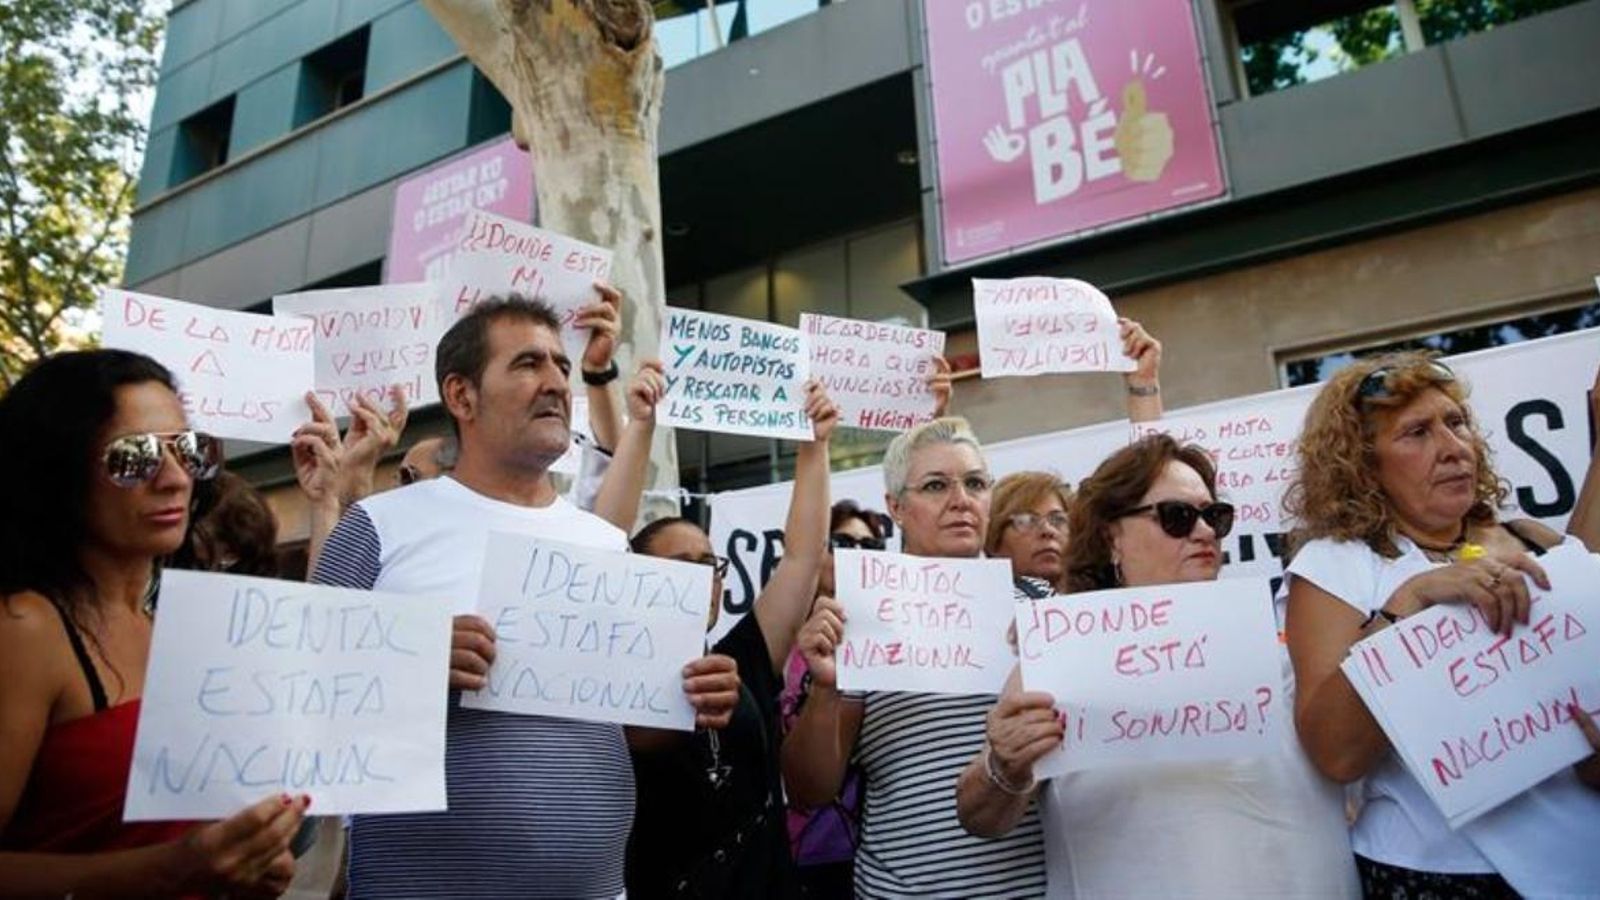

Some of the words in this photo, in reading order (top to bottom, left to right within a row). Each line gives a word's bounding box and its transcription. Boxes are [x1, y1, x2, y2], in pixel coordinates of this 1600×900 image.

[1002, 38, 1100, 130] PLA
[1029, 98, 1122, 205] BÉ
[125, 298, 166, 331] DE
[186, 317, 229, 343] LA
[669, 315, 731, 342] MENOS
[740, 326, 800, 354] BANCOS
[331, 342, 430, 377] ESTAFA
[673, 344, 695, 368] Y
[694, 350, 795, 380] AUTOPISTAS
[885, 355, 928, 374] QUE
[665, 374, 679, 394] Y
[683, 376, 761, 402] RESCATAR
[772, 386, 788, 402] A
[669, 402, 702, 423] LAS
[522, 547, 700, 616] IDENTAL
[861, 555, 975, 599] IDENTAL
[227, 586, 418, 655] IDENTAL
[496, 607, 655, 659] ESTAFA
[876, 598, 972, 632] ESTAFA
[1023, 600, 1173, 660] ¿DONDE
[1115, 633, 1208, 675] ESTÁ
[1448, 613, 1587, 698] ESTAFA
[198, 666, 384, 719] ESTAFA
[1102, 686, 1272, 743] SONRISA?
[149, 734, 394, 795] NACIONAL
